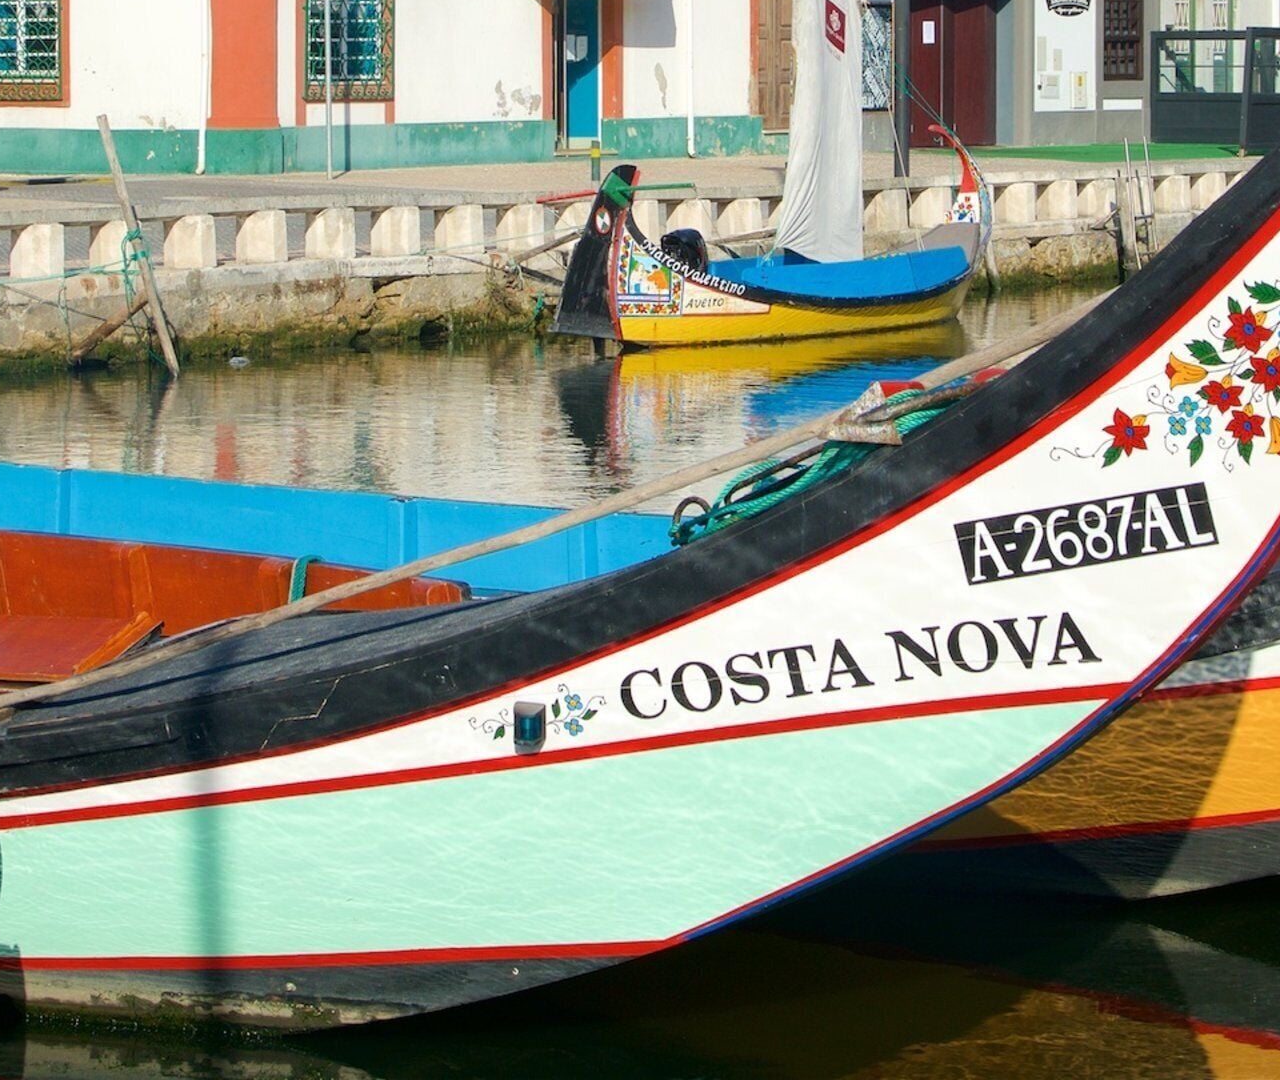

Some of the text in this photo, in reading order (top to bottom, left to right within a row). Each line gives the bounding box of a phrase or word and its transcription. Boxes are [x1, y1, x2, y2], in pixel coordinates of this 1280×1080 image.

[640, 239, 746, 296] Marco Valentino
[971, 487, 1216, 583] A-2687-AL
[619, 611, 1103, 720] COSTA NOVA
